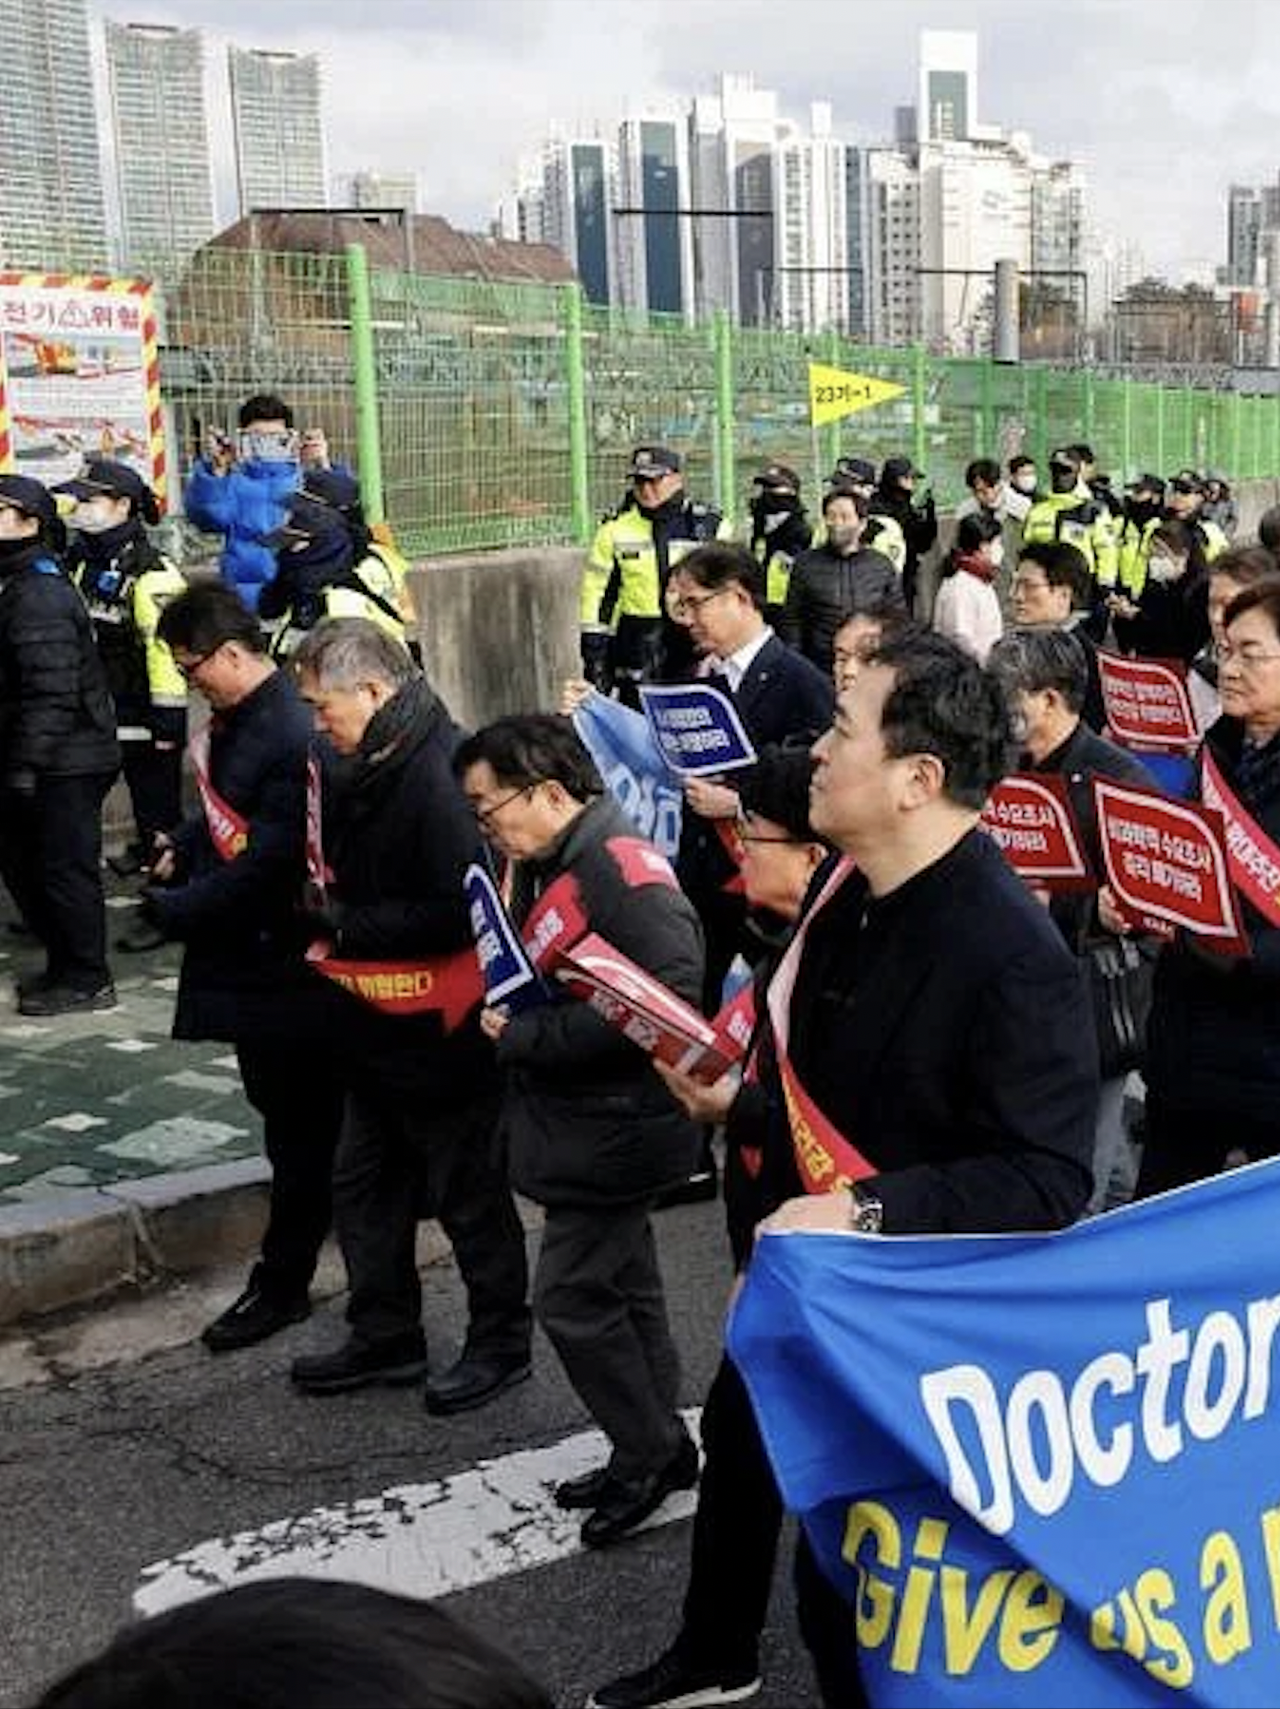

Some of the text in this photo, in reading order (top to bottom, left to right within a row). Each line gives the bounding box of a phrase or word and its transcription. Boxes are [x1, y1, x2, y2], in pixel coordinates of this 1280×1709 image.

[3, 300, 140, 330] 전기 위험
[815, 384, 871, 402] 23기-1
[842, 1501, 1064, 1676] Give
[1090, 1567, 1194, 1690] us
[1201, 1531, 1252, 1666] a
